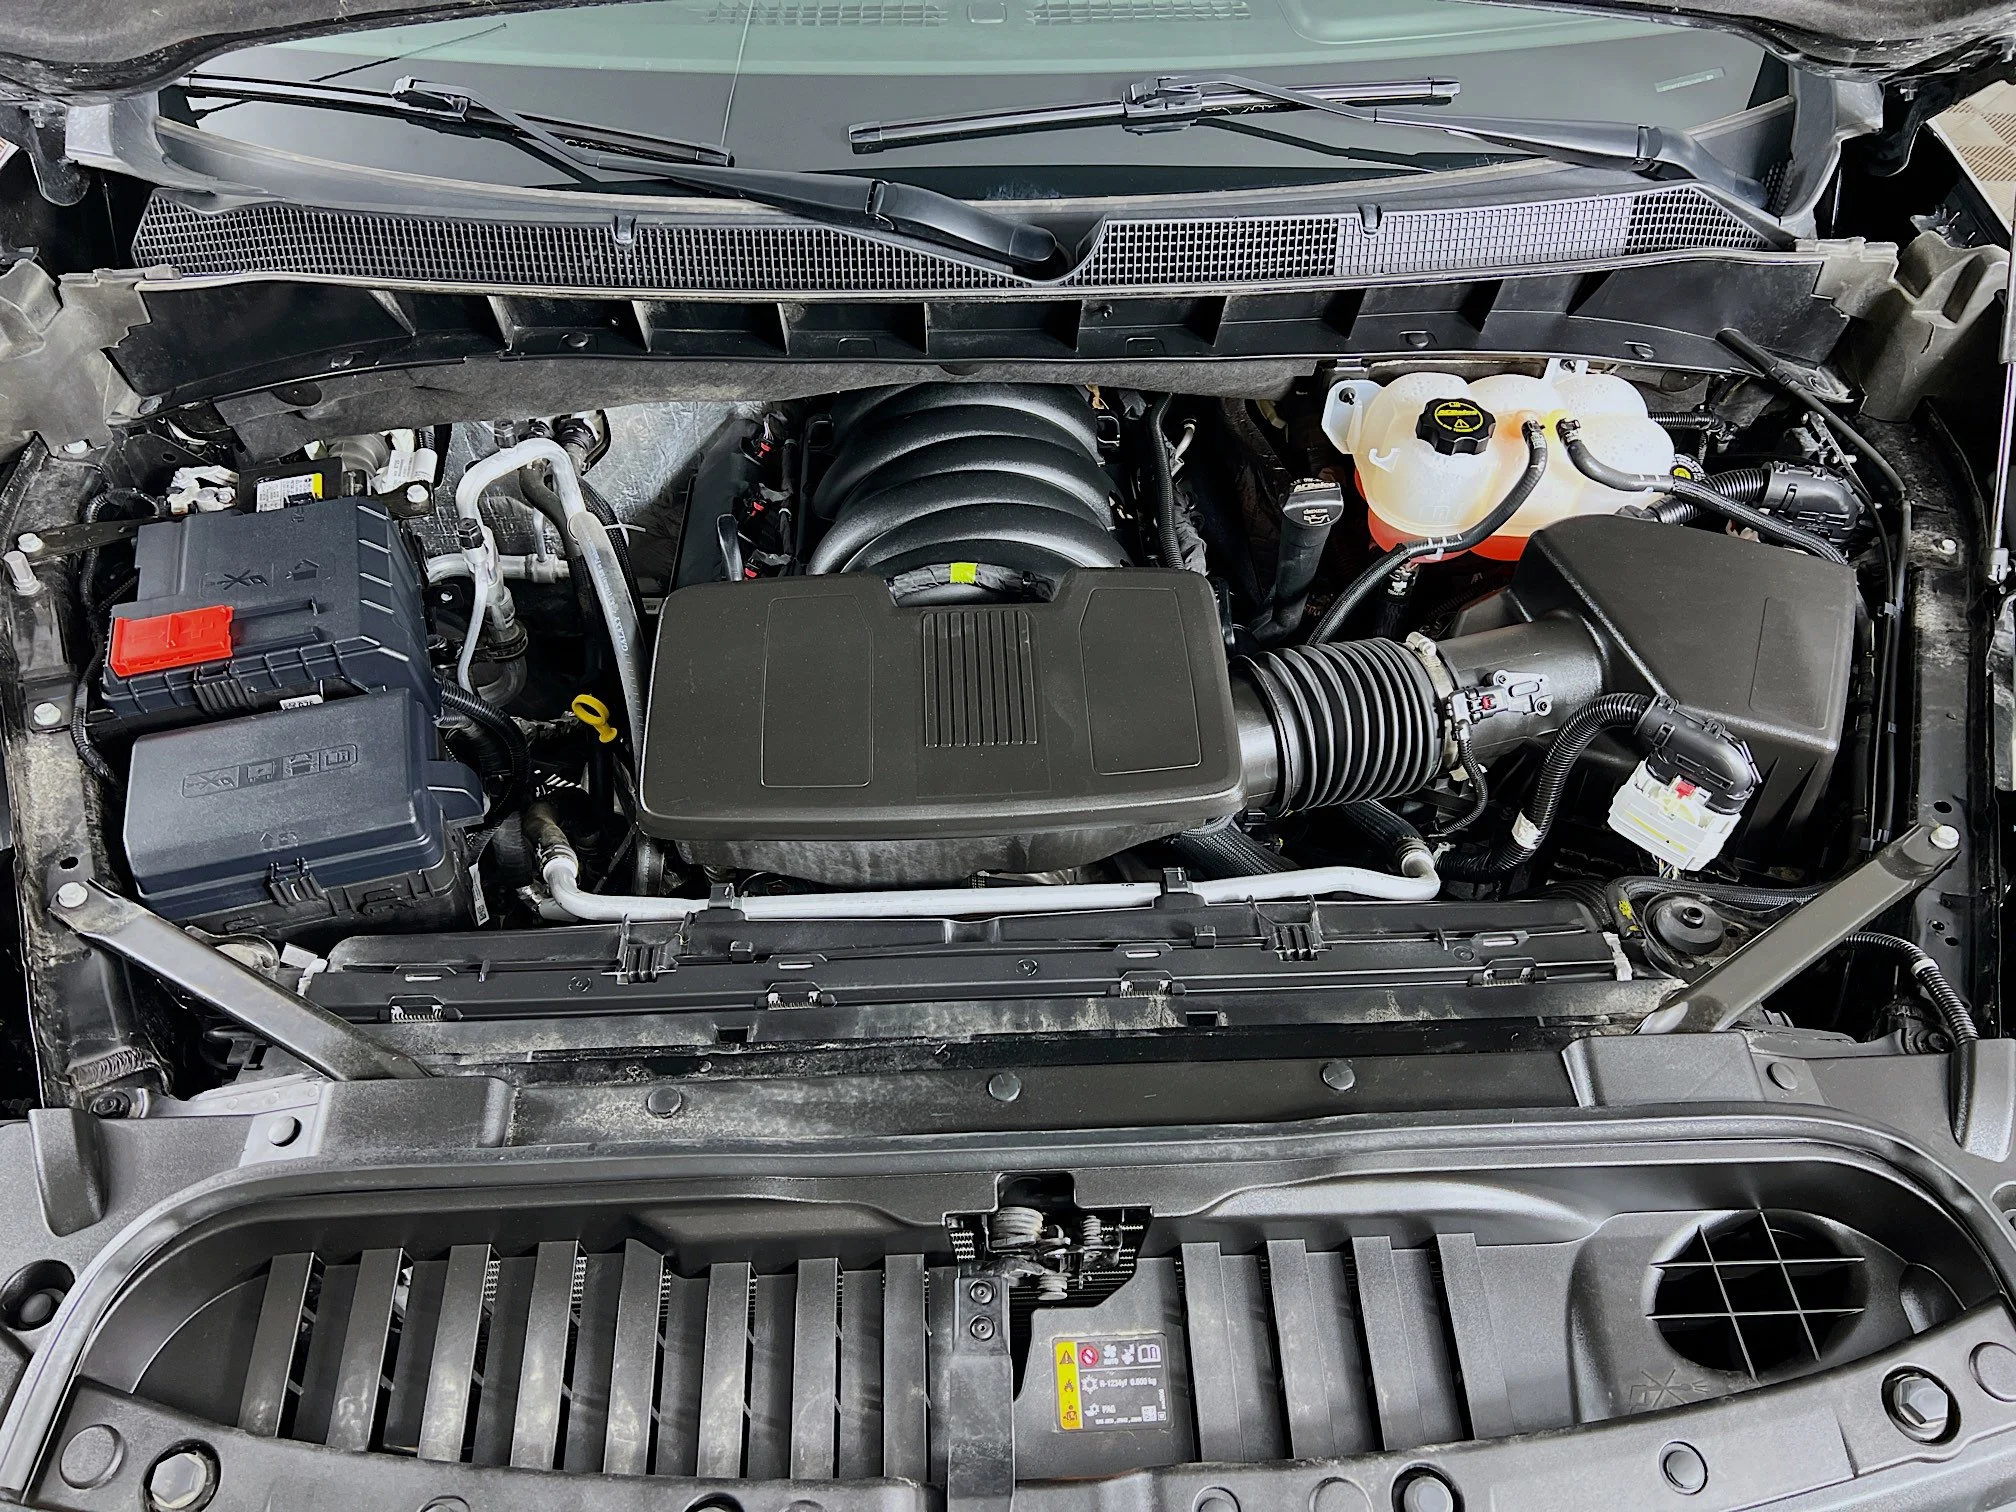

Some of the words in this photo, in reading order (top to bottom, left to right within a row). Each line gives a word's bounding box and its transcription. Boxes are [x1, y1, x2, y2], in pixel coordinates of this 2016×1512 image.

[612, 616, 629, 652] GALAXY
[1100, 1379, 1128, 1388] R-1234yf
[1148, 1378, 1156, 1386] kg
